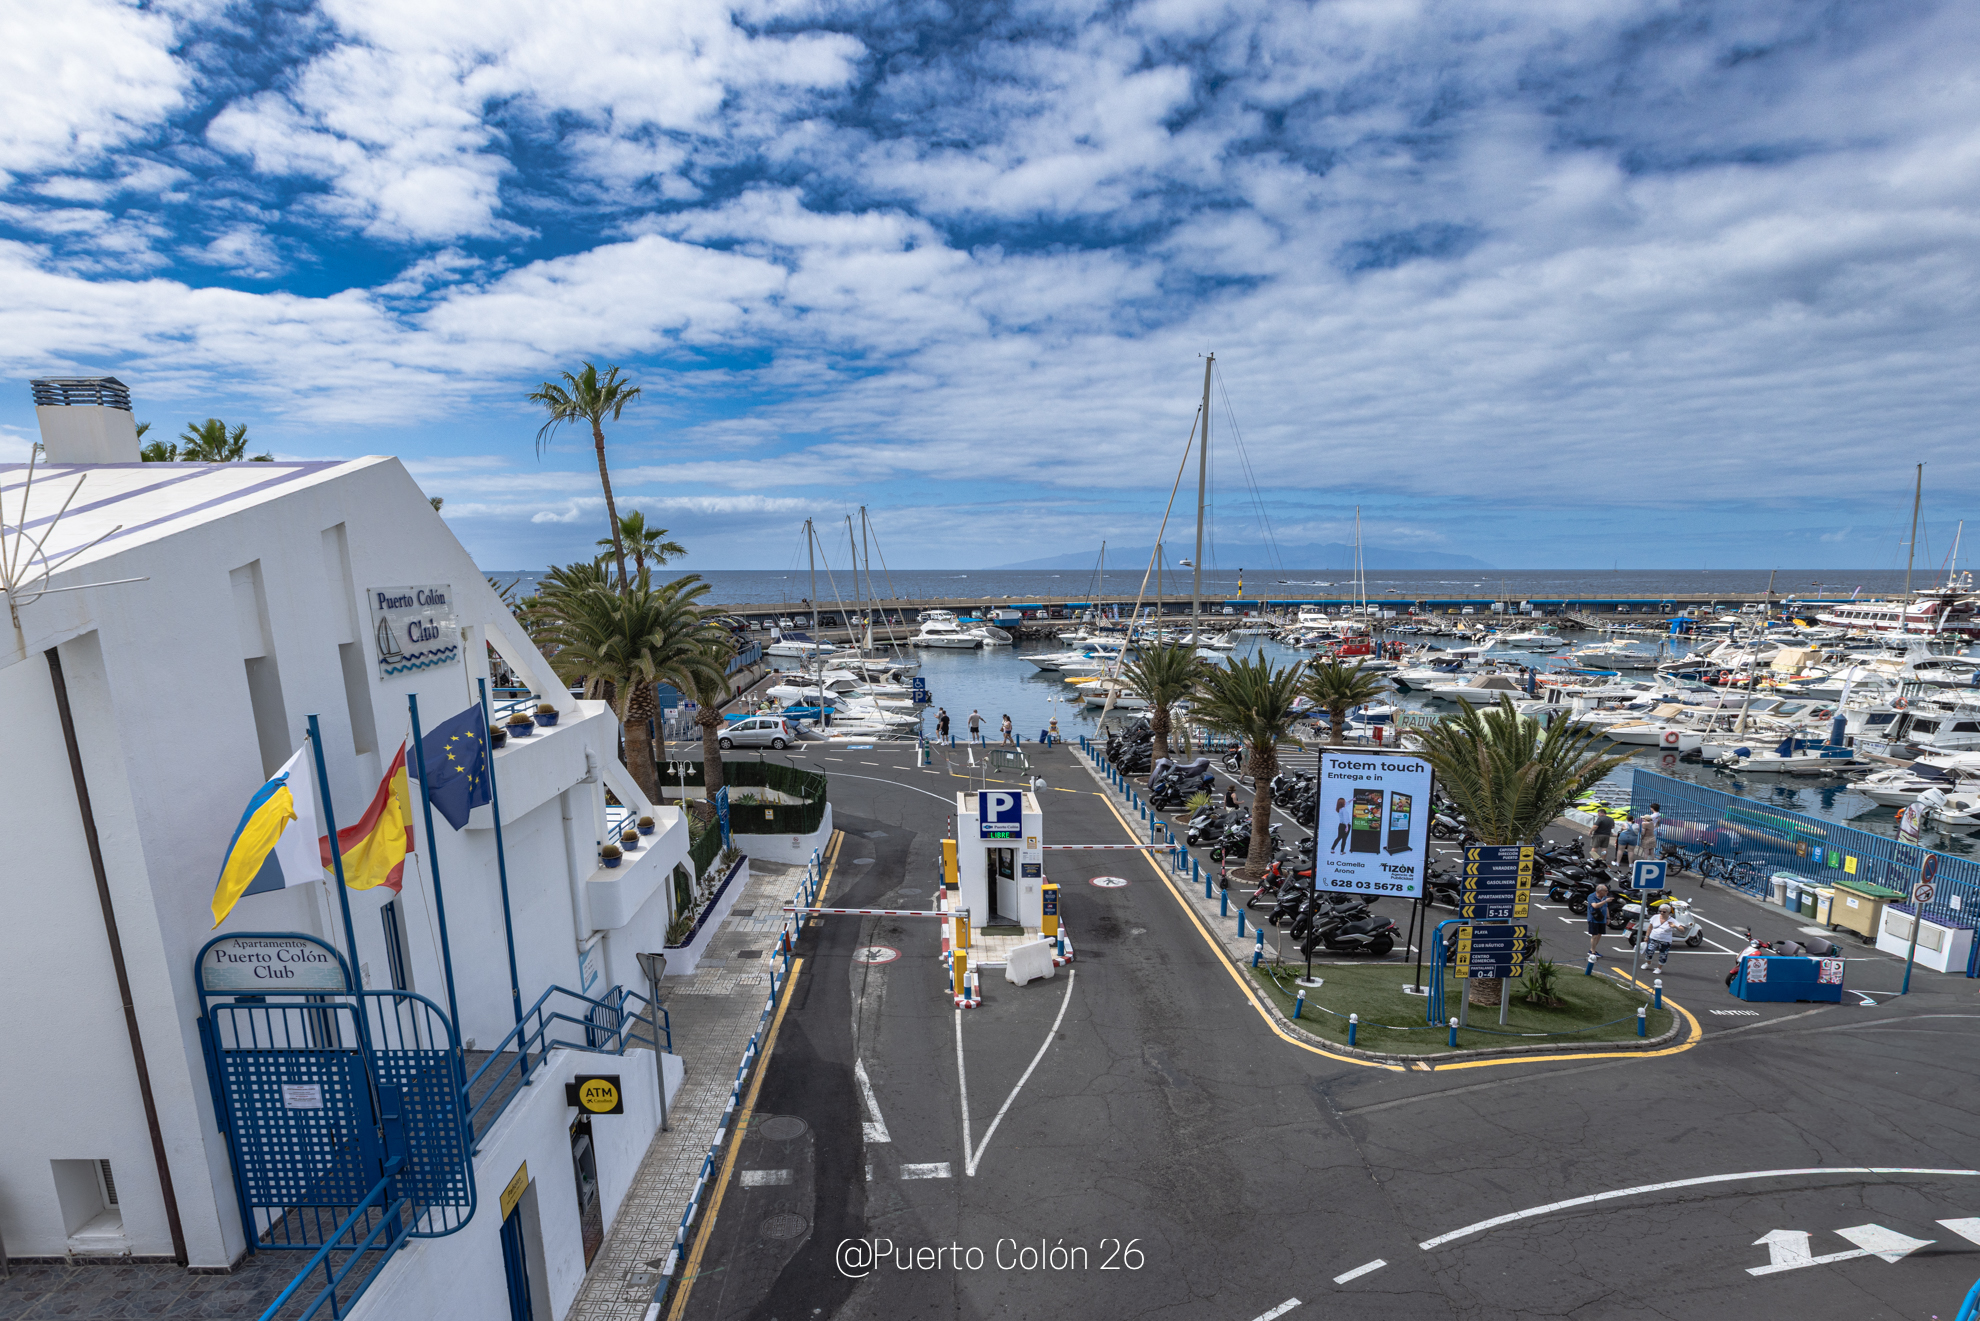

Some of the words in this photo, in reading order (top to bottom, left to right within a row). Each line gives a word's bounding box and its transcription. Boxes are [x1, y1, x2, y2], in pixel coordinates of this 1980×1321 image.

[377, 592, 414, 610] Puerto
[417, 589, 446, 606] Colón
[407, 618, 440, 643] Club
[915, 691, 924, 702] P
[1329, 759, 1377, 771] Totem
[1381, 762, 1425, 773] touch
[1327, 772, 1364, 781] Entrega
[987, 792, 1014, 822] P
[1336, 860, 1365, 868] Camella
[1380, 863, 1415, 874] TIZÓN
[1639, 864, 1660, 886] P
[1331, 879, 1353, 888] 628
[1356, 881, 1371, 890] 03
[1374, 882, 1404, 892] 5678
[1489, 909, 1509, 917] 5-15
[232, 939, 307, 949] Apartamentos
[215, 949, 272, 963] Puerto
[276, 948, 329, 963] Colón
[253, 965, 295, 979] Club
[586, 1088, 612, 1098] ATM
